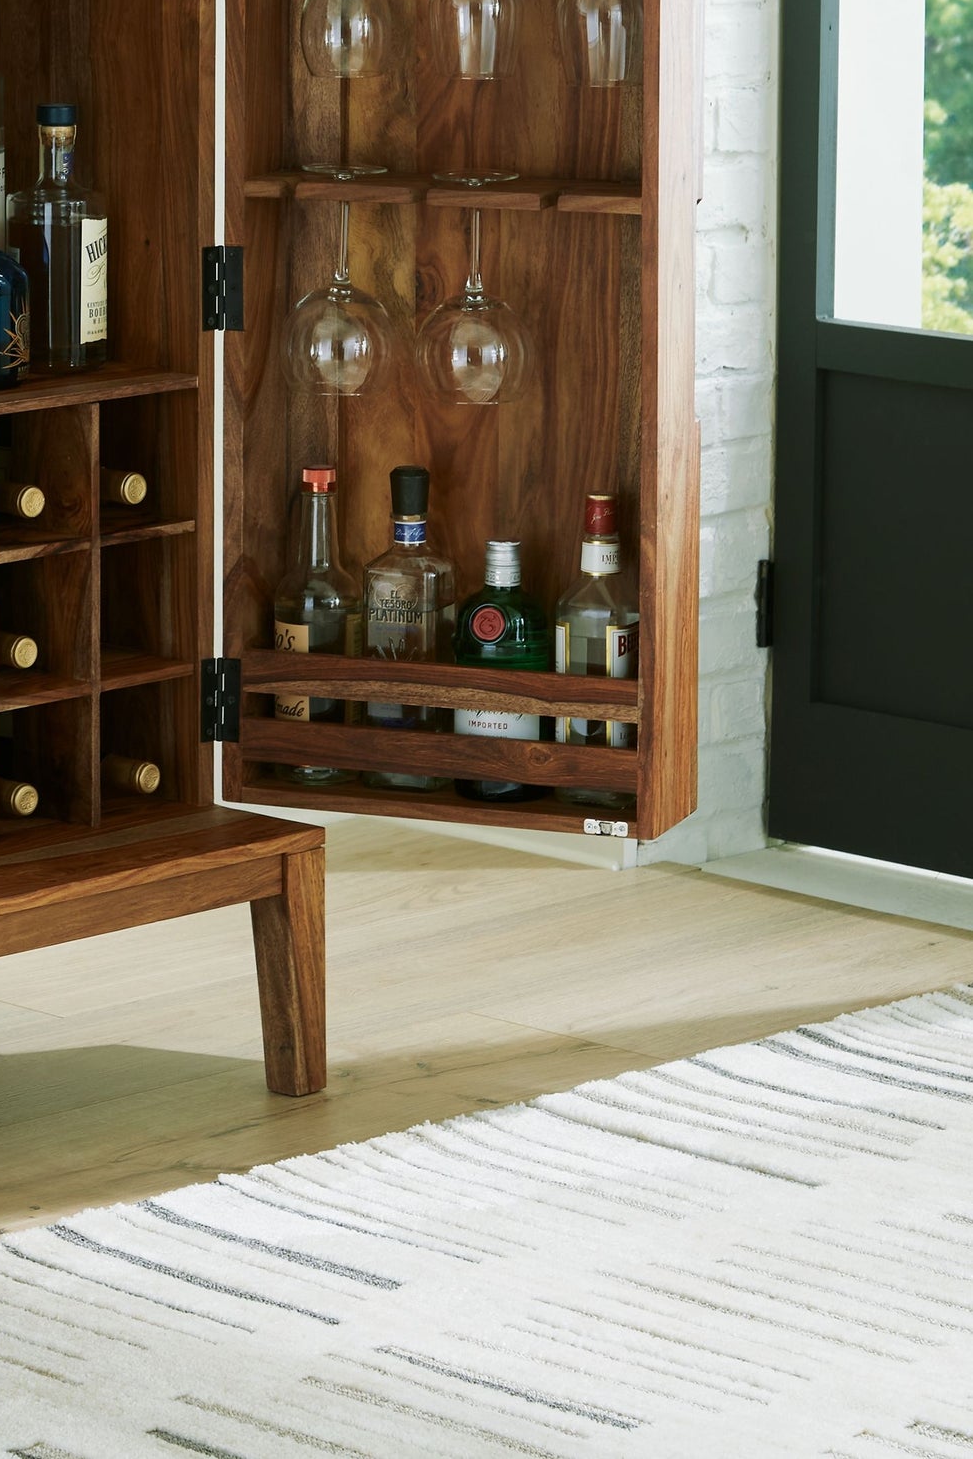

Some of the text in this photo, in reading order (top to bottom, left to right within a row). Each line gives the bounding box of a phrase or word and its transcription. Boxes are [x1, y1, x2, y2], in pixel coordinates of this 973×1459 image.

[390, 590, 401, 599] EL
[379, 598, 413, 610] TESORO
[368, 608, 423, 625] PLATINUM
[468, 719, 508, 730] IMPORTED
